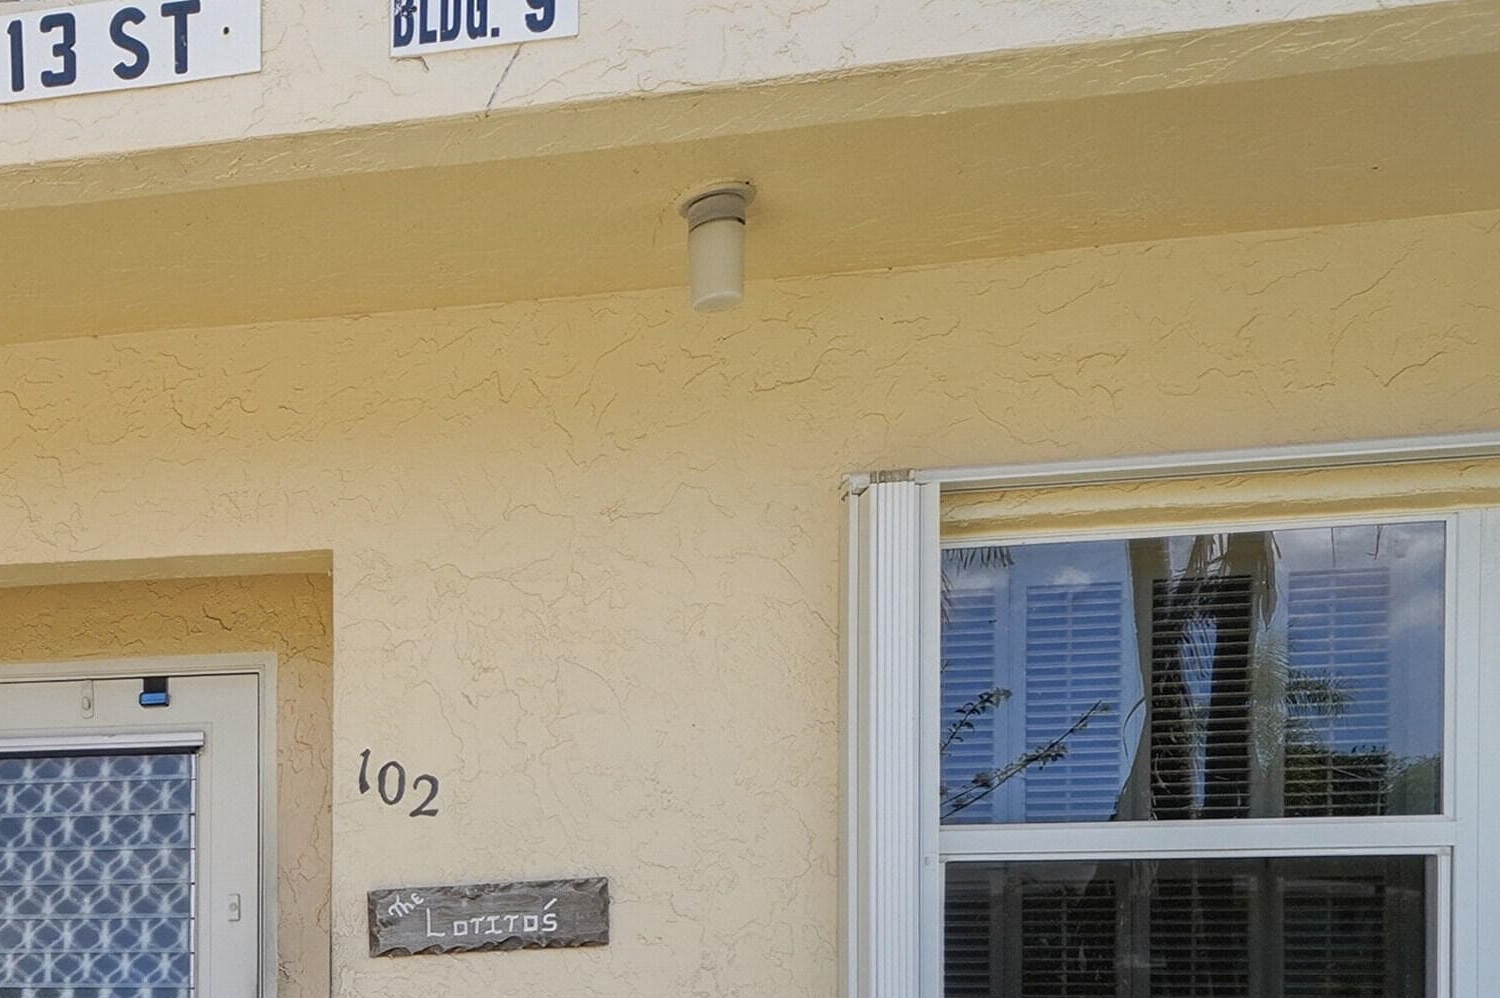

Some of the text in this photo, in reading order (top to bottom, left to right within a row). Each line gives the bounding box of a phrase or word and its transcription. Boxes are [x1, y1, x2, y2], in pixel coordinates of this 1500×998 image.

[7, 13, 76, 92] 13
[109, 0, 200, 80] ST
[358, 748, 439, 817] 102
